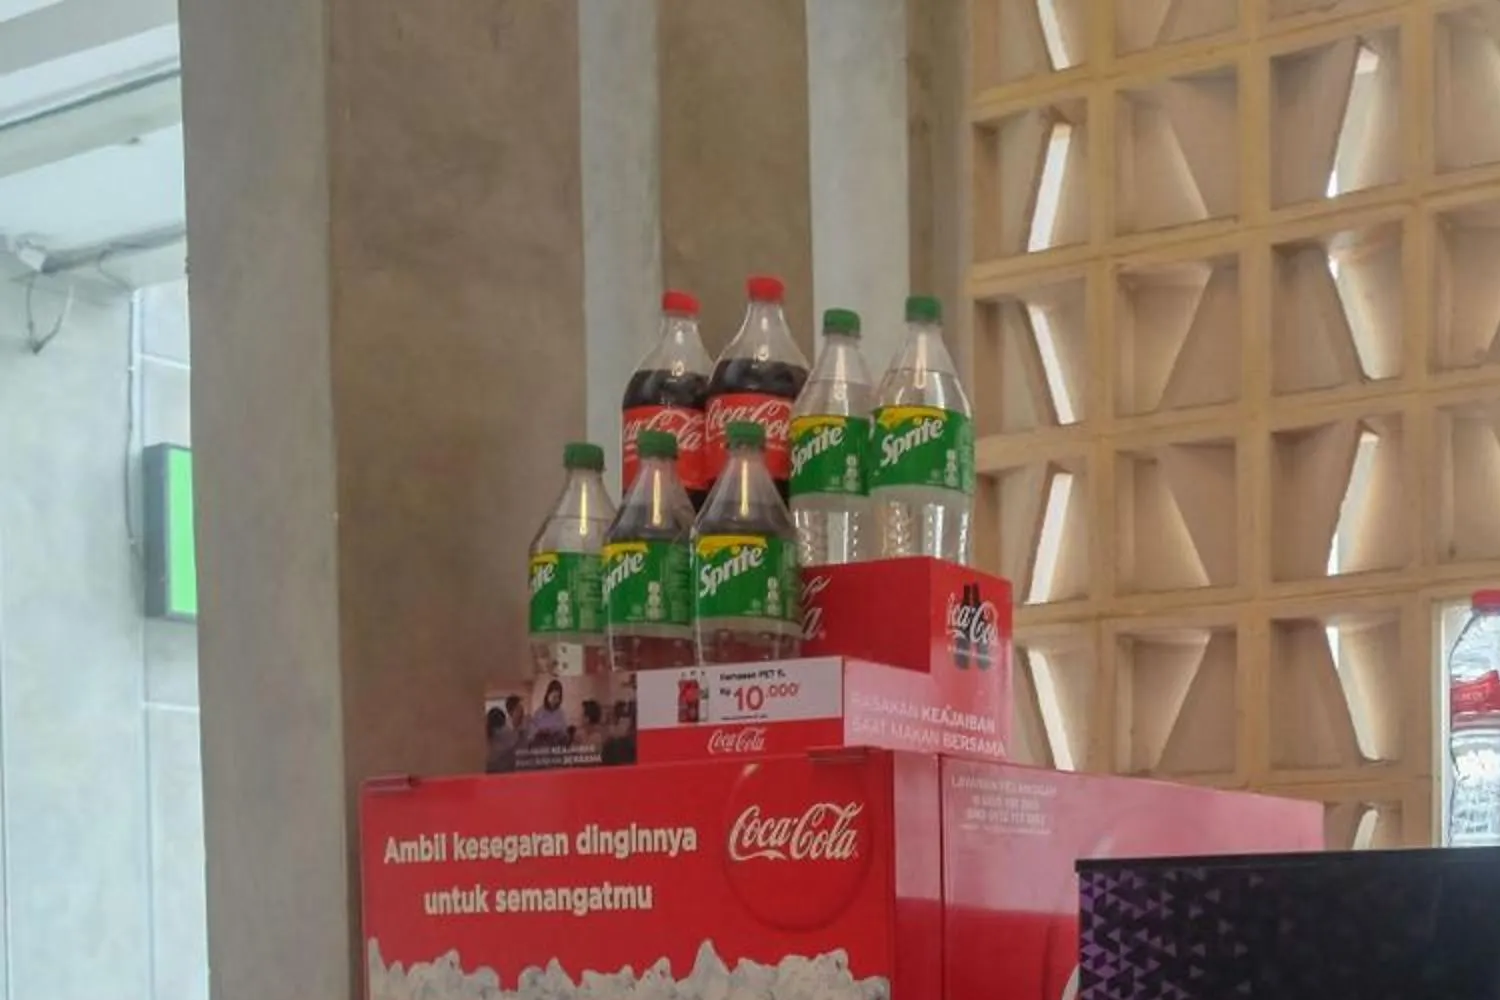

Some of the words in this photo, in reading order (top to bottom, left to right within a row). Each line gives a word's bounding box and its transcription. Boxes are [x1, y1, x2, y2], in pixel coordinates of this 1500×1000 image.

[880, 417, 944, 467] Sprite
[532, 563, 556, 593] ite
[602, 552, 645, 609] prite
[699, 546, 765, 598] Sprite
[922, 705, 996, 735] KEAJAIBAN
[943, 732, 1007, 758] BERSAMA
[384, 832, 447, 864] Ambil
[453, 828, 569, 863] kesegaran
[576, 824, 698, 858] dinginnya
[728, 801, 864, 861] Coca-Cola
[424, 884, 489, 915] untuk
[494, 882, 653, 916] semangatmu
